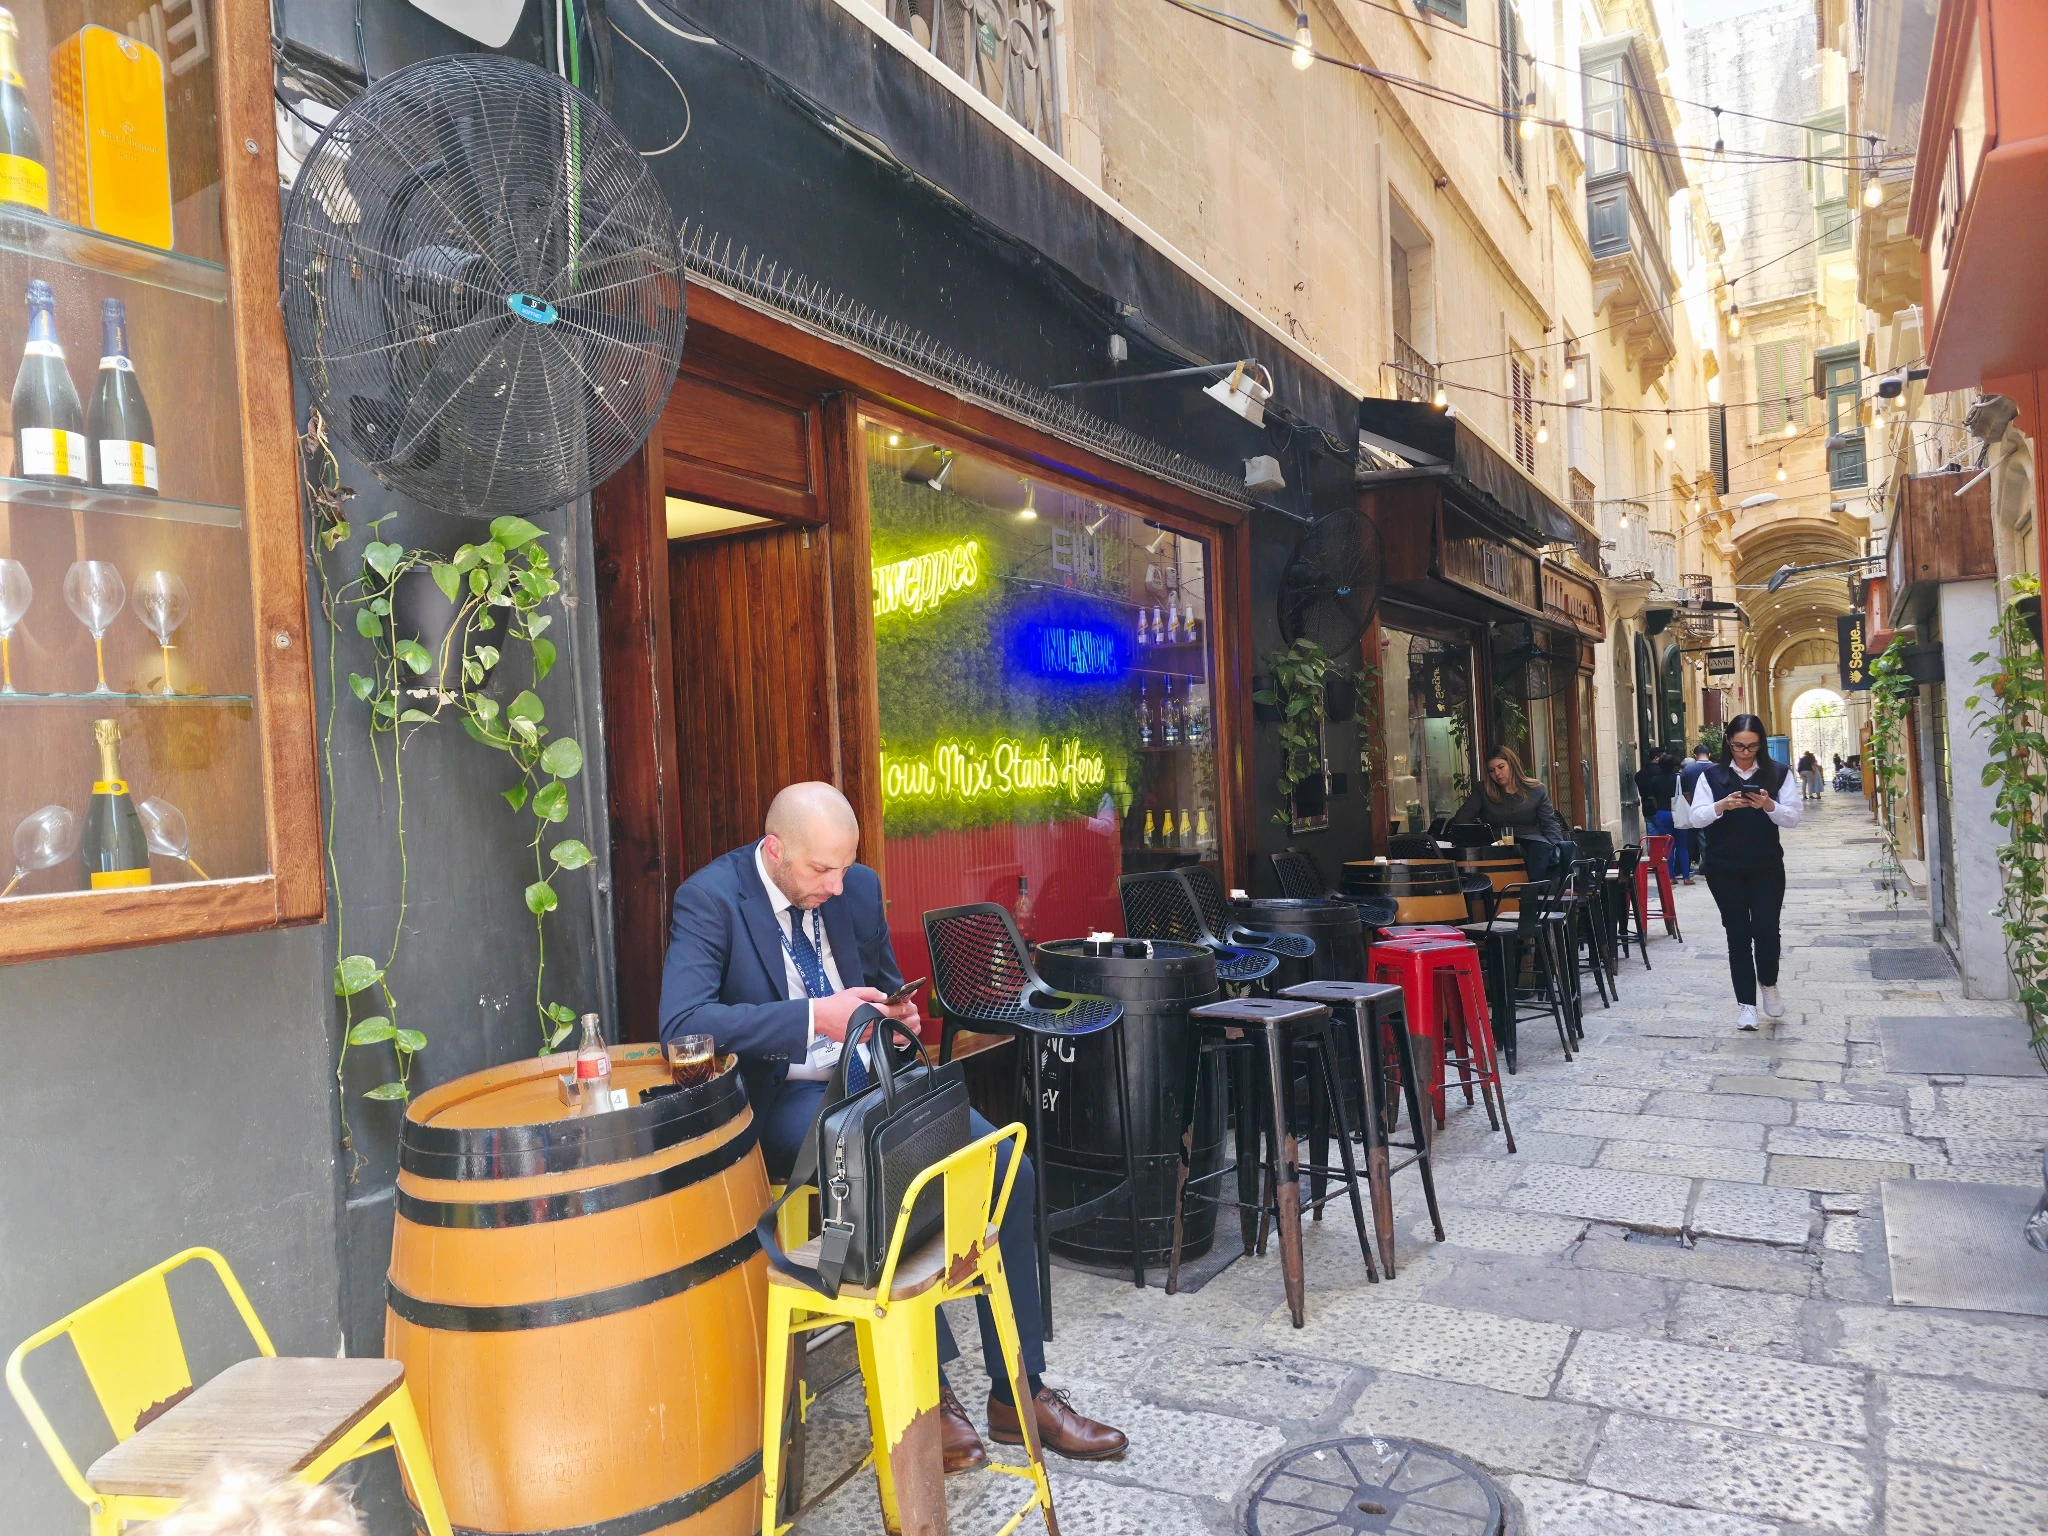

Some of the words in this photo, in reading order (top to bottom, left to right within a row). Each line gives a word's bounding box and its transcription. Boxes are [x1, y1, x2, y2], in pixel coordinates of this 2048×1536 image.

[939, 744, 992, 797] Mix
[995, 743, 1058, 793] Starts
[1062, 740, 1104, 798] Here
[1042, 1093, 1060, 1112] EY
